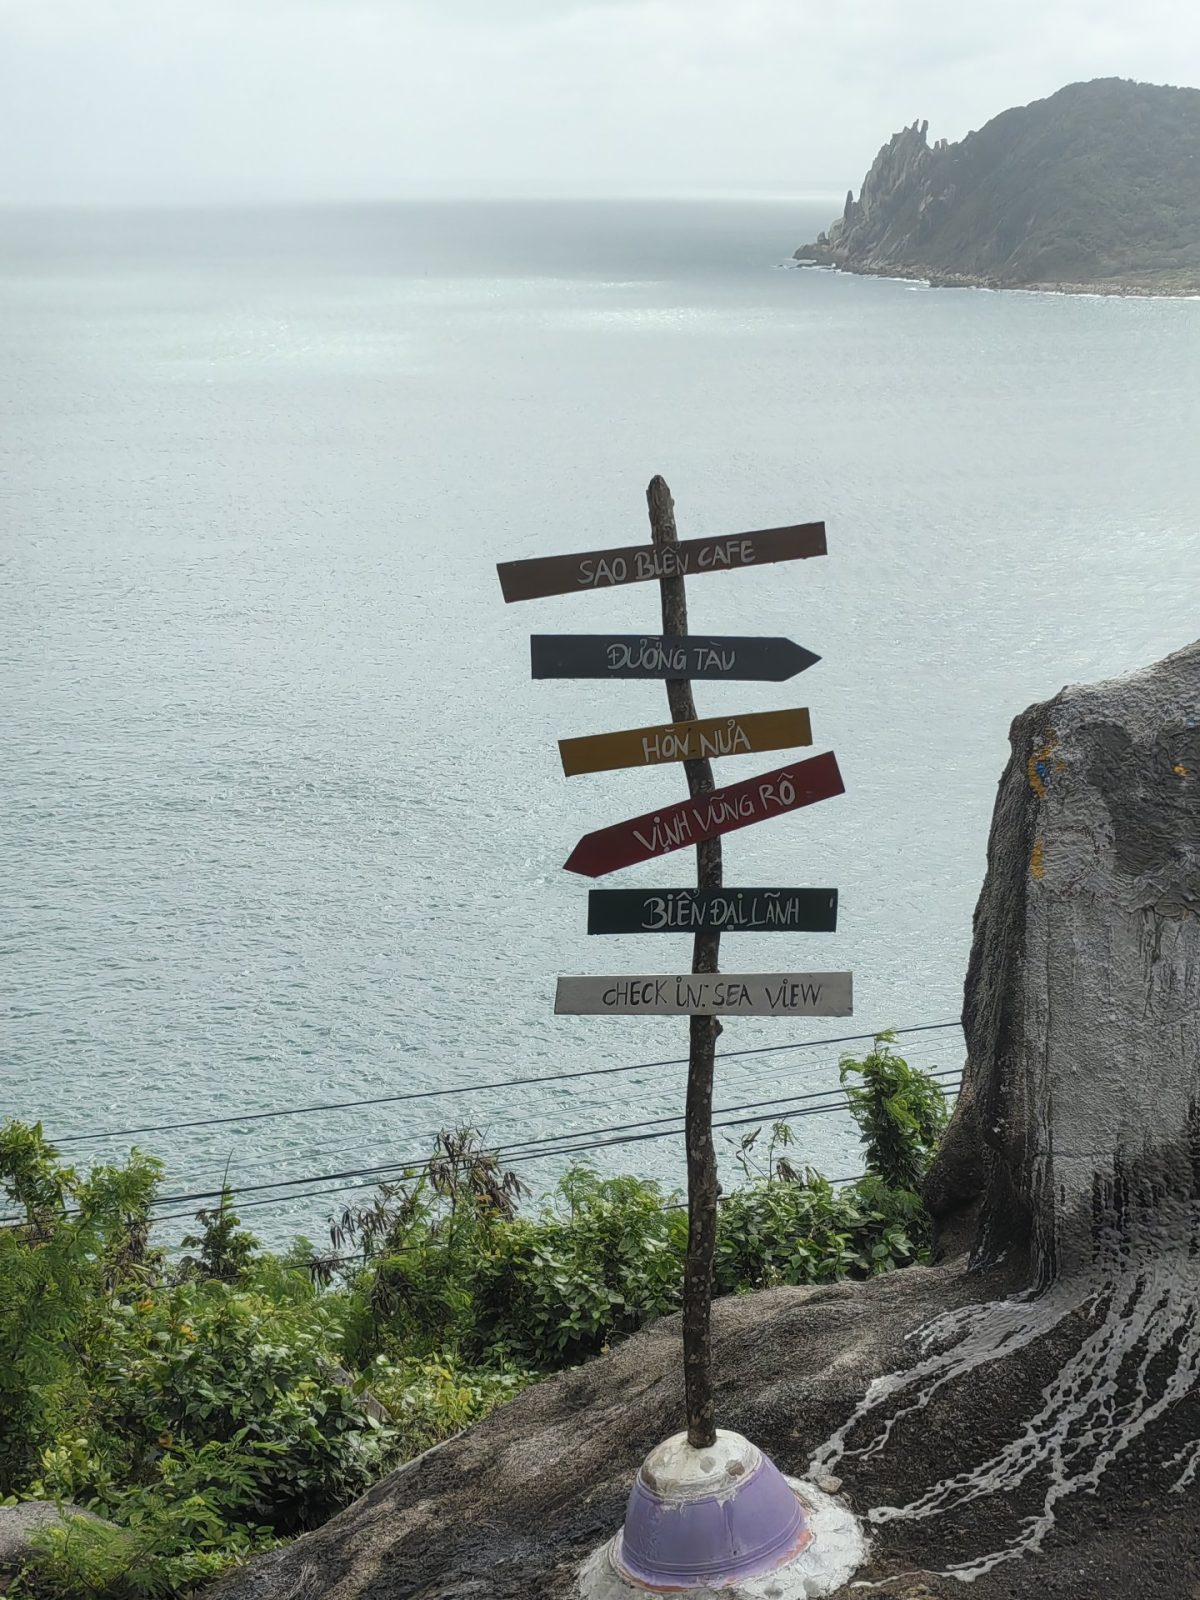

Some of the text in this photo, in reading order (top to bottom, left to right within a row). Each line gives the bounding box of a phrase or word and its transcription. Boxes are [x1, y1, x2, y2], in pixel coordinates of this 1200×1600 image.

[577, 557, 627, 586] SAO
[698, 540, 756, 566] CAFE
[693, 640, 736, 671] TÀU
[692, 793, 755, 832] VŨNG
[641, 889, 799, 931] BIỂN ĐẠI LÃNH
[602, 979, 668, 1006] CHECK
[712, 982, 753, 1007] SEA
[764, 978, 823, 1009] VIEW
